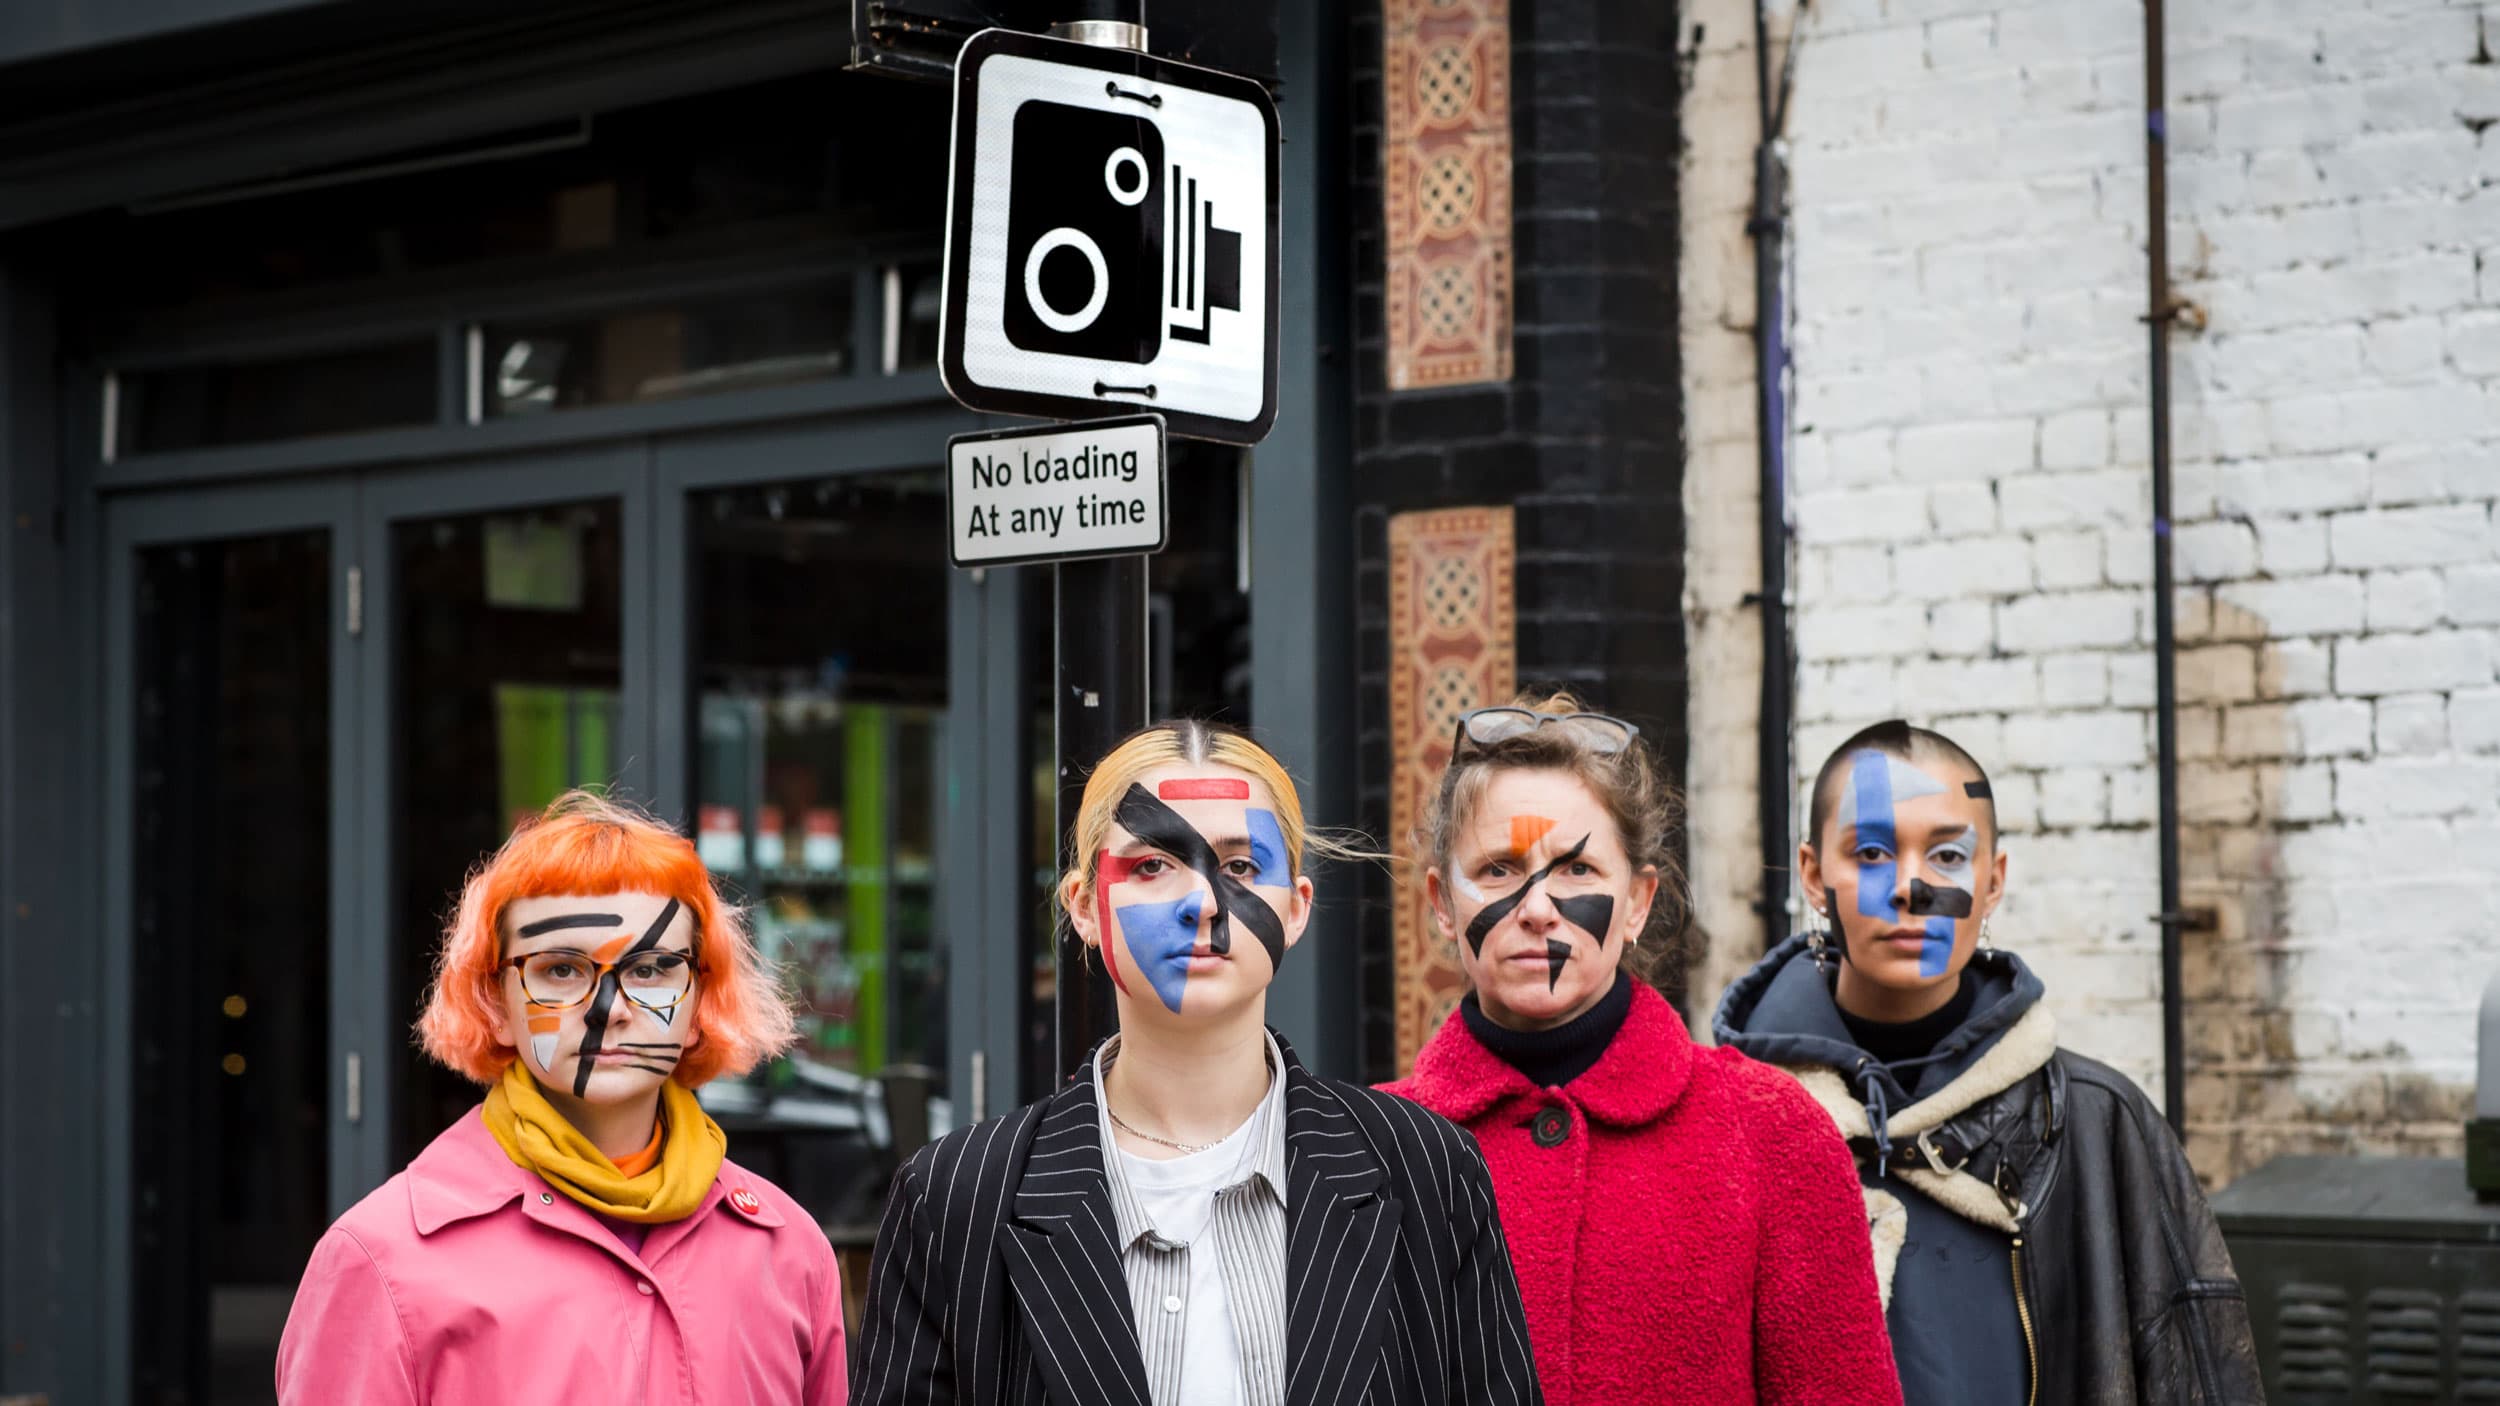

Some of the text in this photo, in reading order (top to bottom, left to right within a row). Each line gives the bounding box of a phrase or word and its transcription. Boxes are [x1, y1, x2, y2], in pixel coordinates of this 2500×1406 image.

[971, 445, 1138, 489] No loading
[968, 494, 1146, 538] At any time
[734, 1191, 759, 1208] NO
